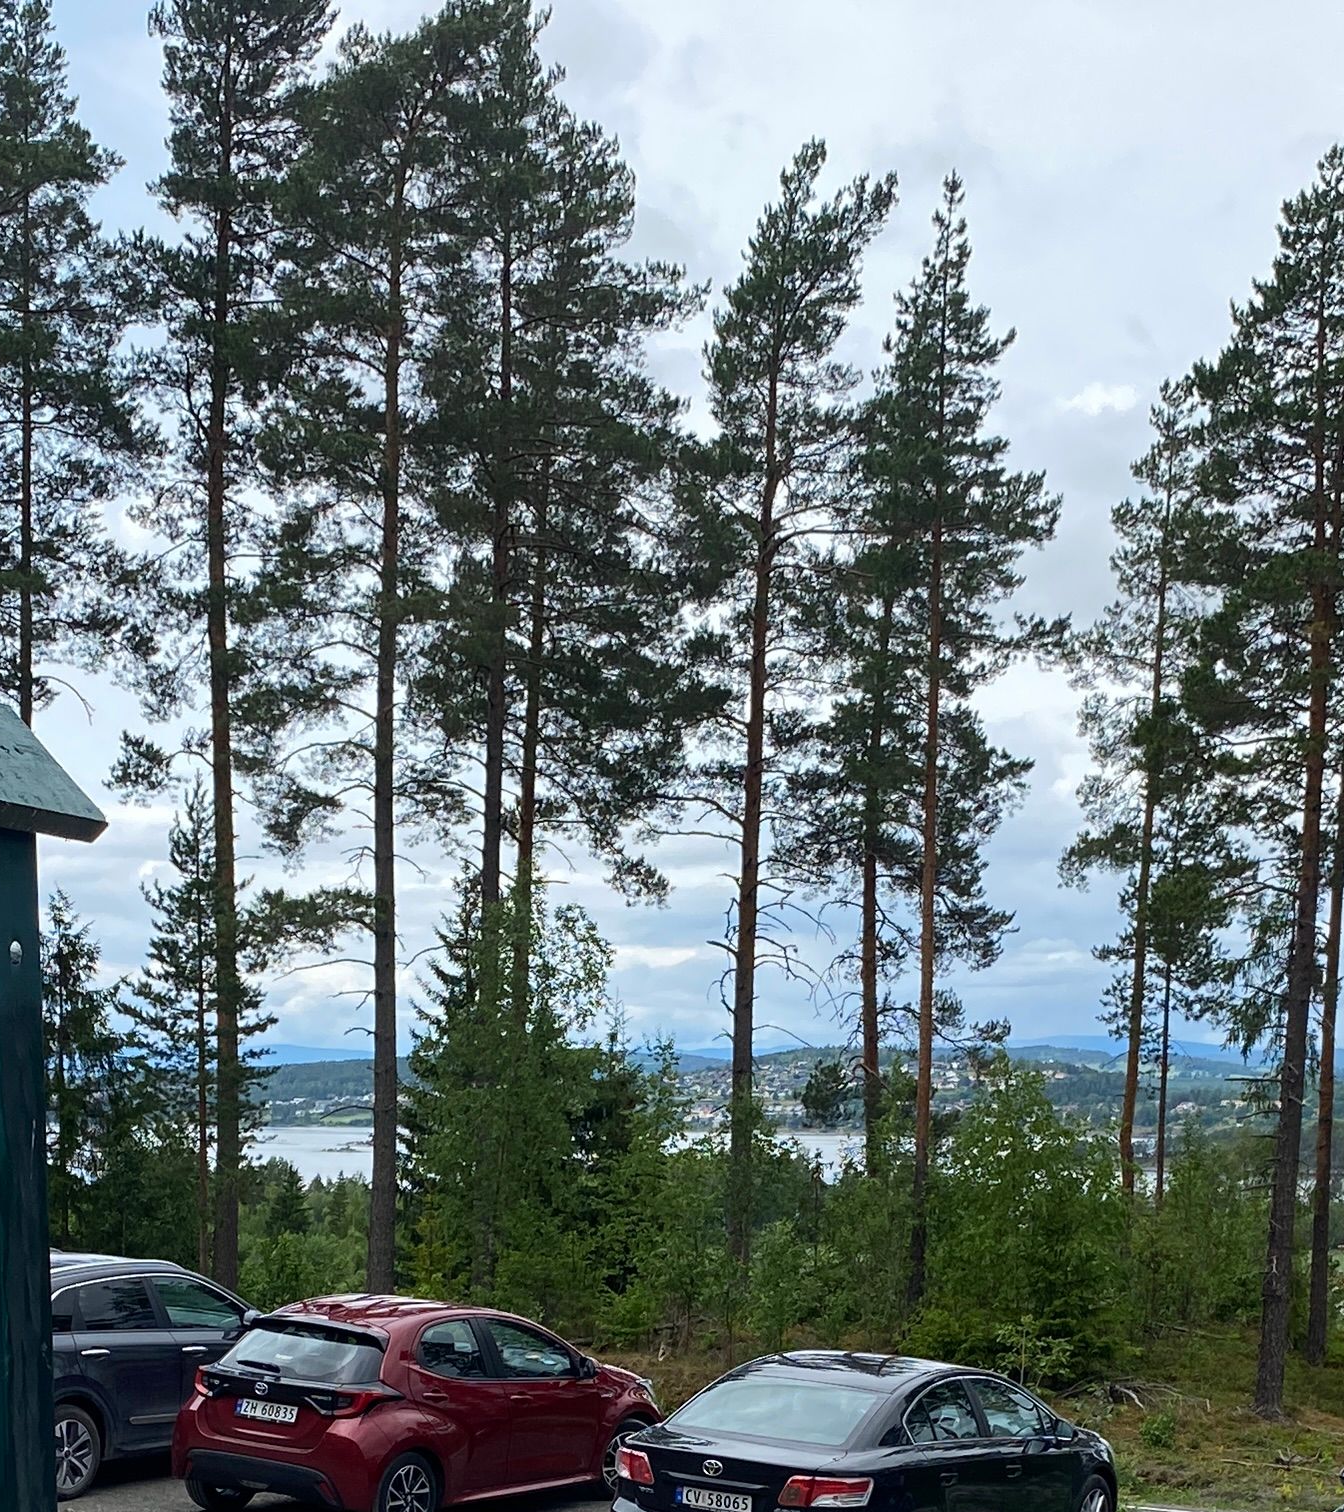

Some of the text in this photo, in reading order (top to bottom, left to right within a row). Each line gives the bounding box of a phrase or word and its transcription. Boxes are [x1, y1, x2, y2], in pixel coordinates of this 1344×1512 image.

[244, 1400, 295, 1421] ZH 60835
[685, 1488, 701, 1505] CV
[706, 1490, 750, 1512] 58065
